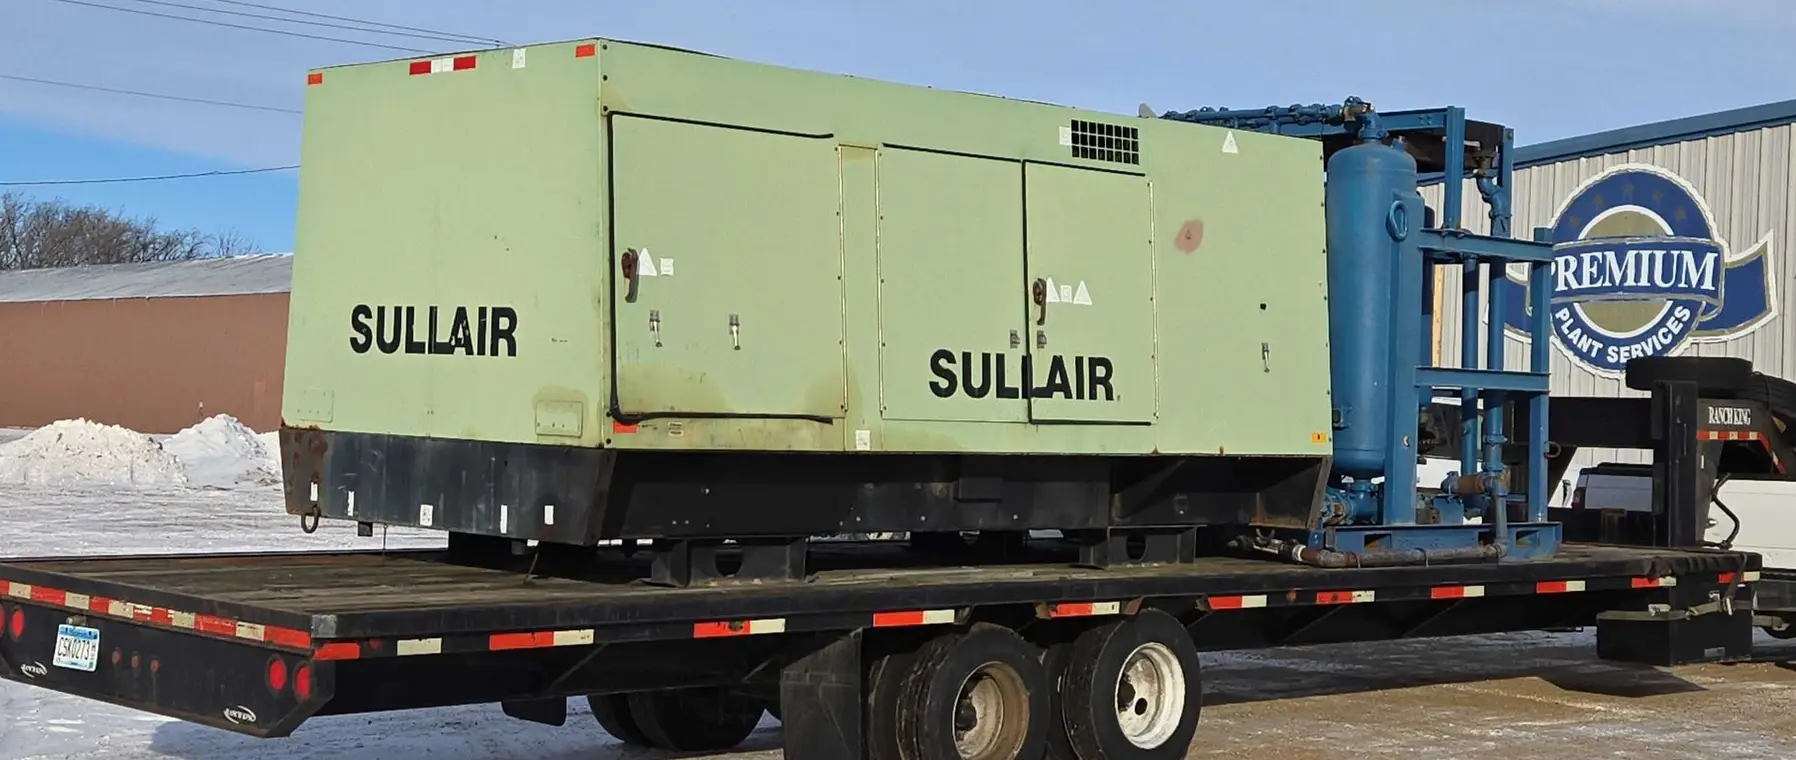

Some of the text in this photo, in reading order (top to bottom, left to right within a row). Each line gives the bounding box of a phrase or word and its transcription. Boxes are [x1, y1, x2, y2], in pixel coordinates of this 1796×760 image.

[1551, 250, 1718, 292] REMIUM
[350, 304, 517, 357] SULLAIR
[1555, 305, 1691, 363] PLANT SERVICES
[929, 349, 1115, 401] SULLAIR
[1707, 406, 1751, 426] RANCH KING
